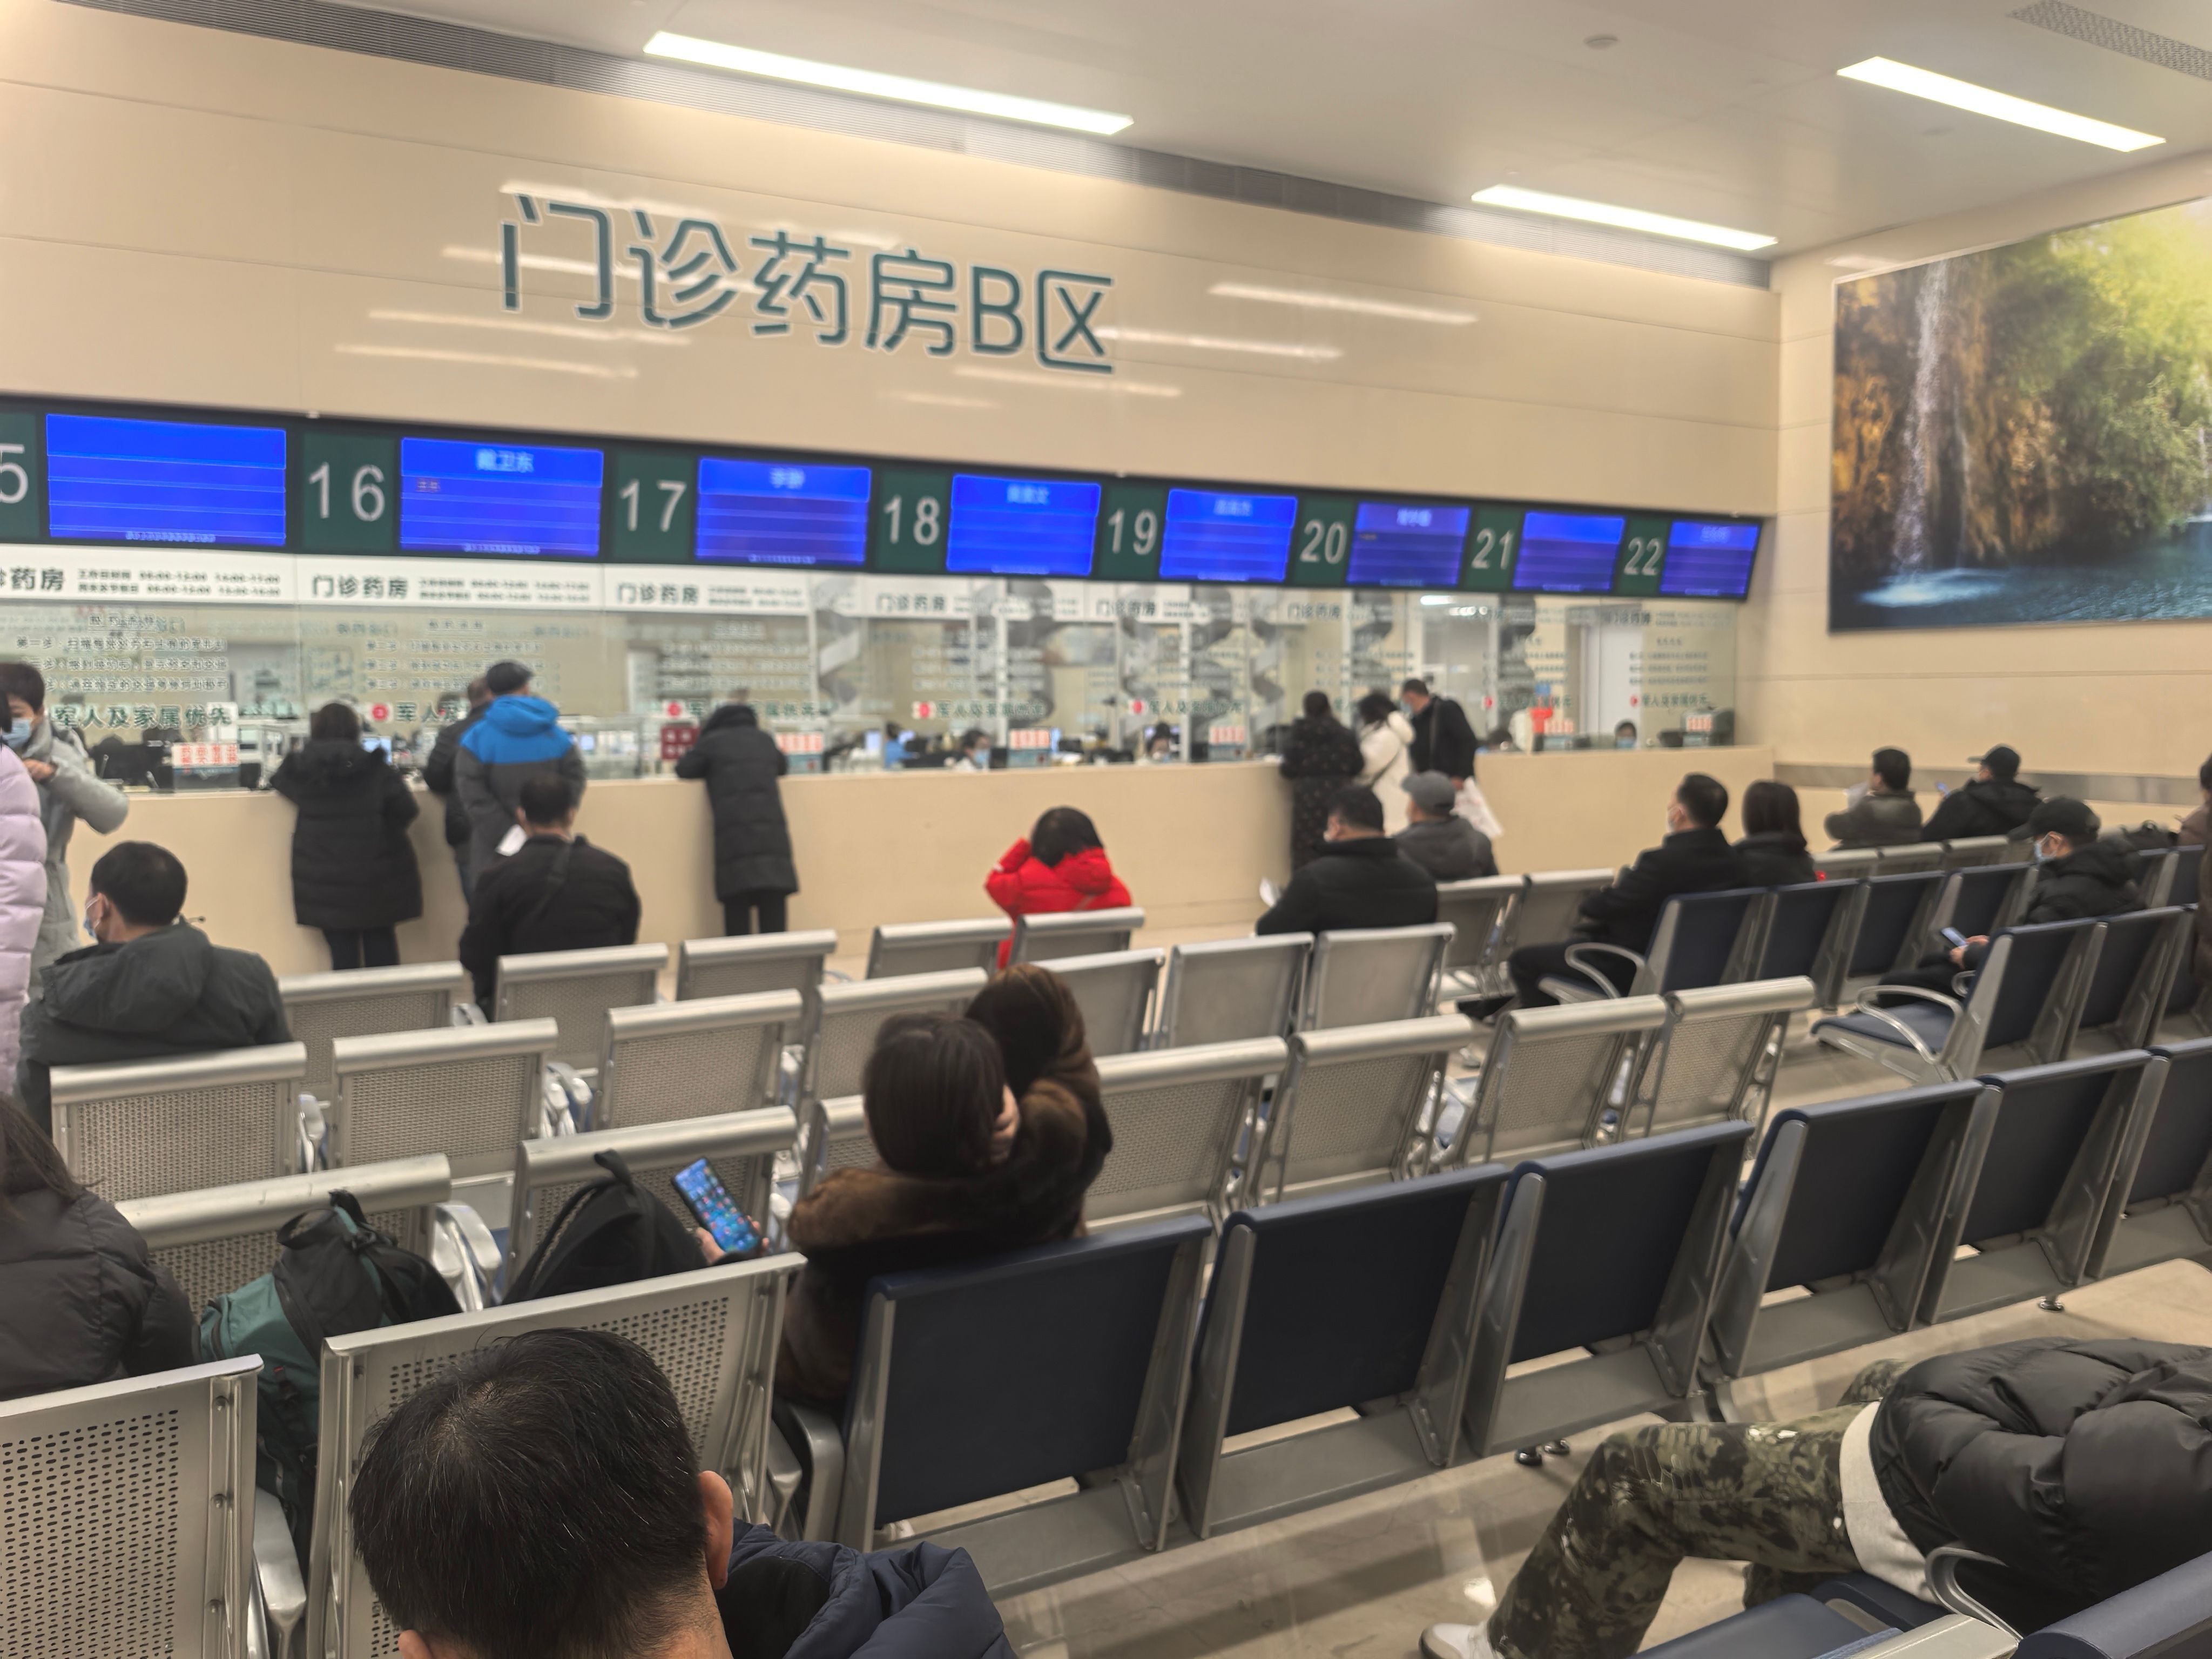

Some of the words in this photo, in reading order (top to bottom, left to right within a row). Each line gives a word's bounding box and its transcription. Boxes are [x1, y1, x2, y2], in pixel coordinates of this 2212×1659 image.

[500, 192, 1114, 375] 门诊药房B区
[308, 462, 385, 521] 16
[620, 478, 686, 531] 17
[884, 494, 940, 545] 18
[1107, 509, 1157, 555] 19
[1299, 520, 1347, 564] 20
[1471, 529, 1513, 570] 21
[1624, 538, 1663, 576] 22
[0, 567, 64, 591] 药房
[312, 576, 408, 599] 门诊药房
[53, 704, 232, 729] 军人及家属优先
